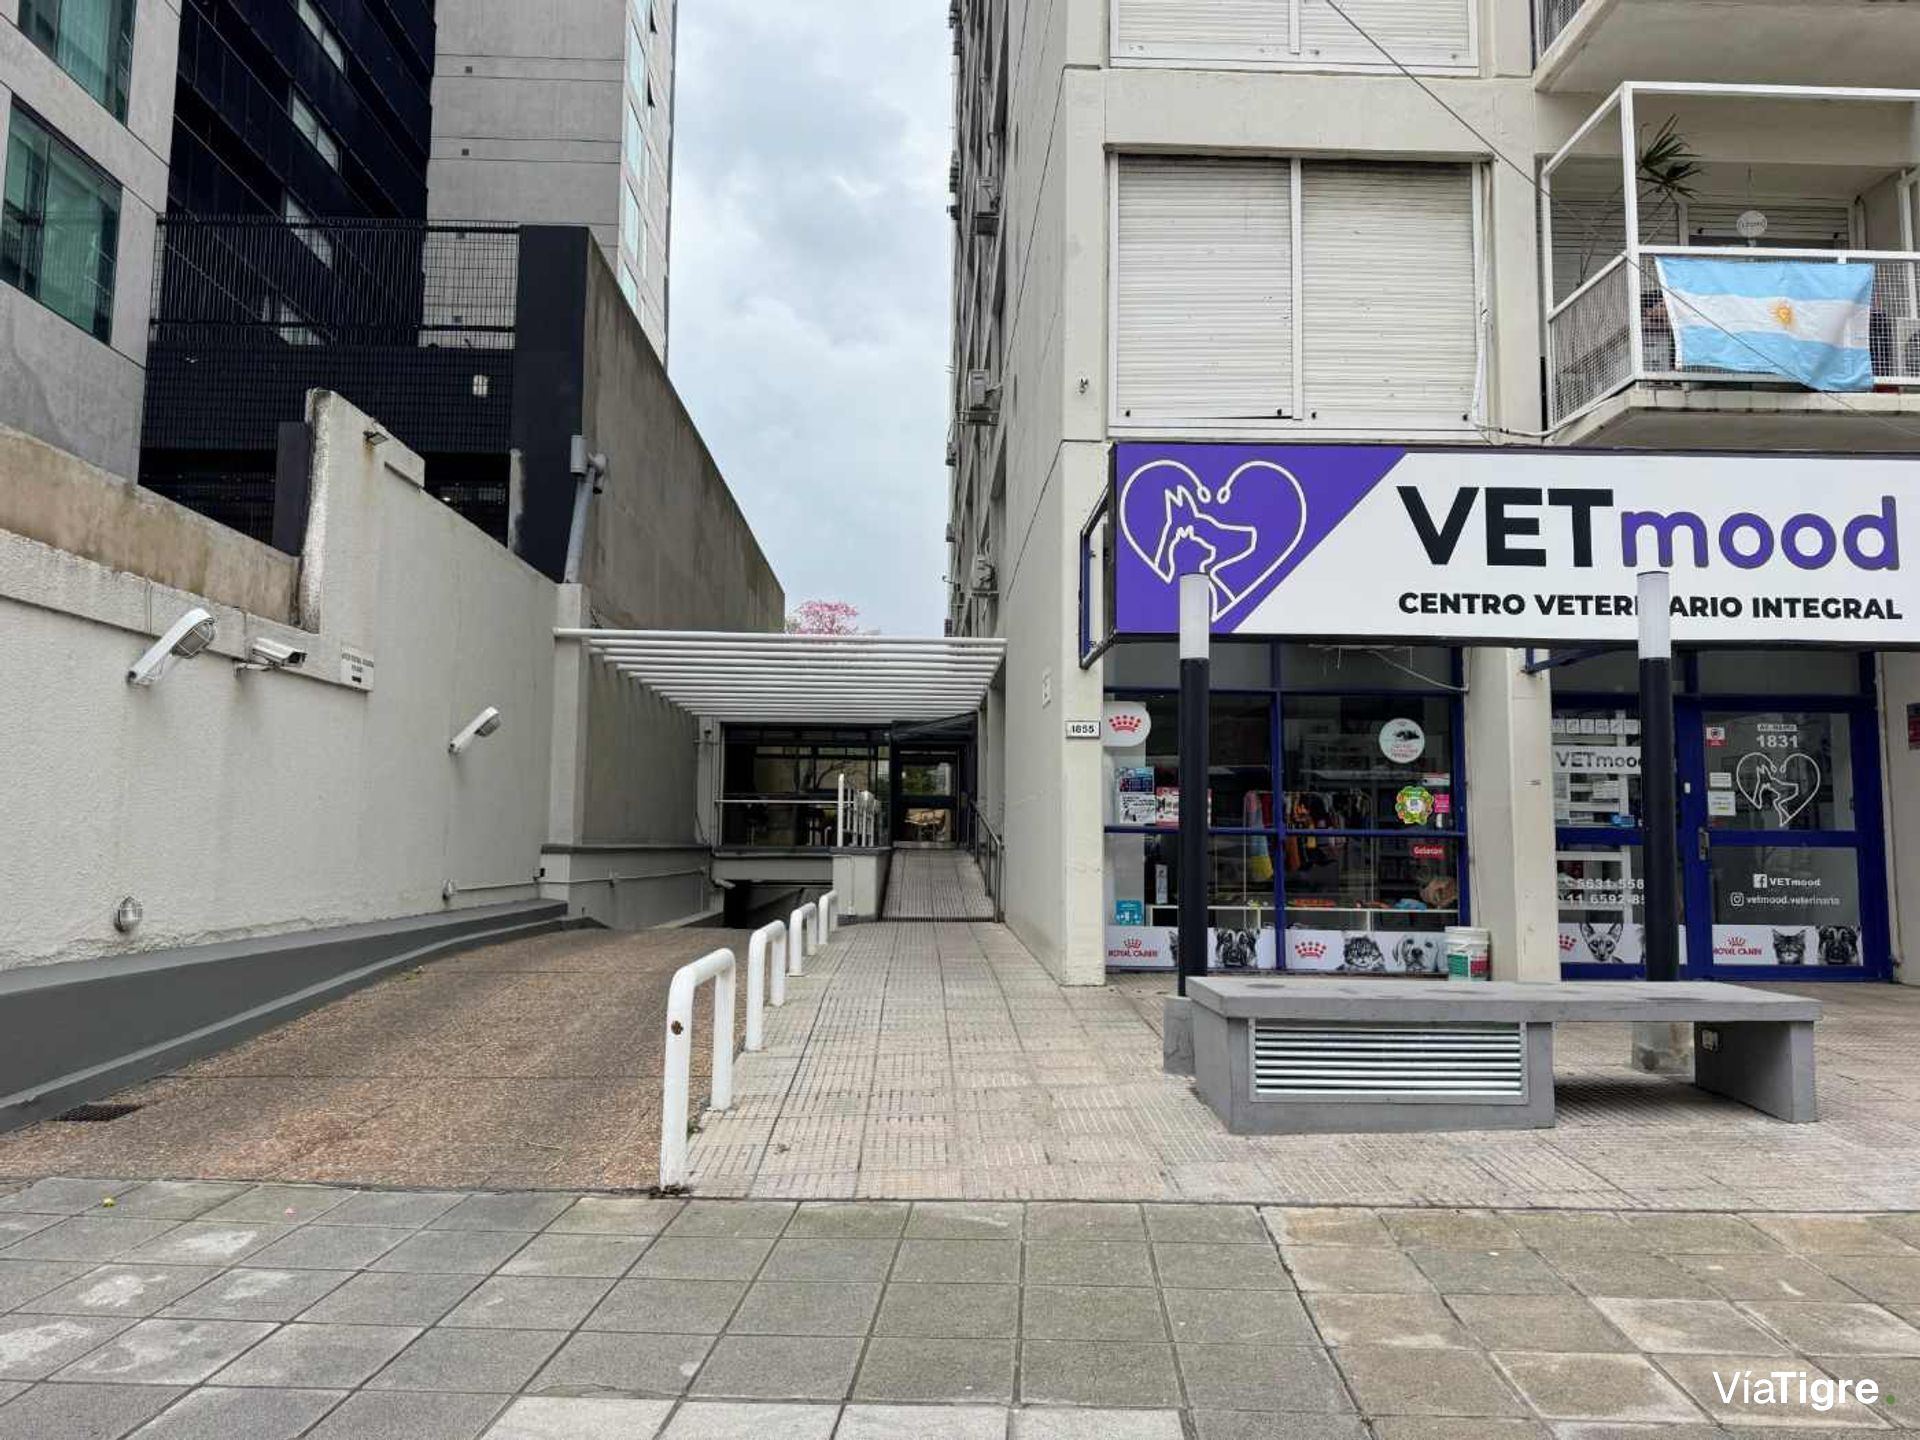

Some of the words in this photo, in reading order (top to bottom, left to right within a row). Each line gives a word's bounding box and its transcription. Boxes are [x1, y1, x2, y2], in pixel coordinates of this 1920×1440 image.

[1396, 485, 1900, 571] VETmood
[1399, 592, 1525, 615] CENTRO
[1534, 594, 1743, 618] VETERIARIO
[1752, 597, 1903, 620] INTEGRAL
[1756, 734, 1798, 748] 1831
[1555, 751, 1642, 768] VETmoo
[1768, 877, 1822, 886] VETmood
